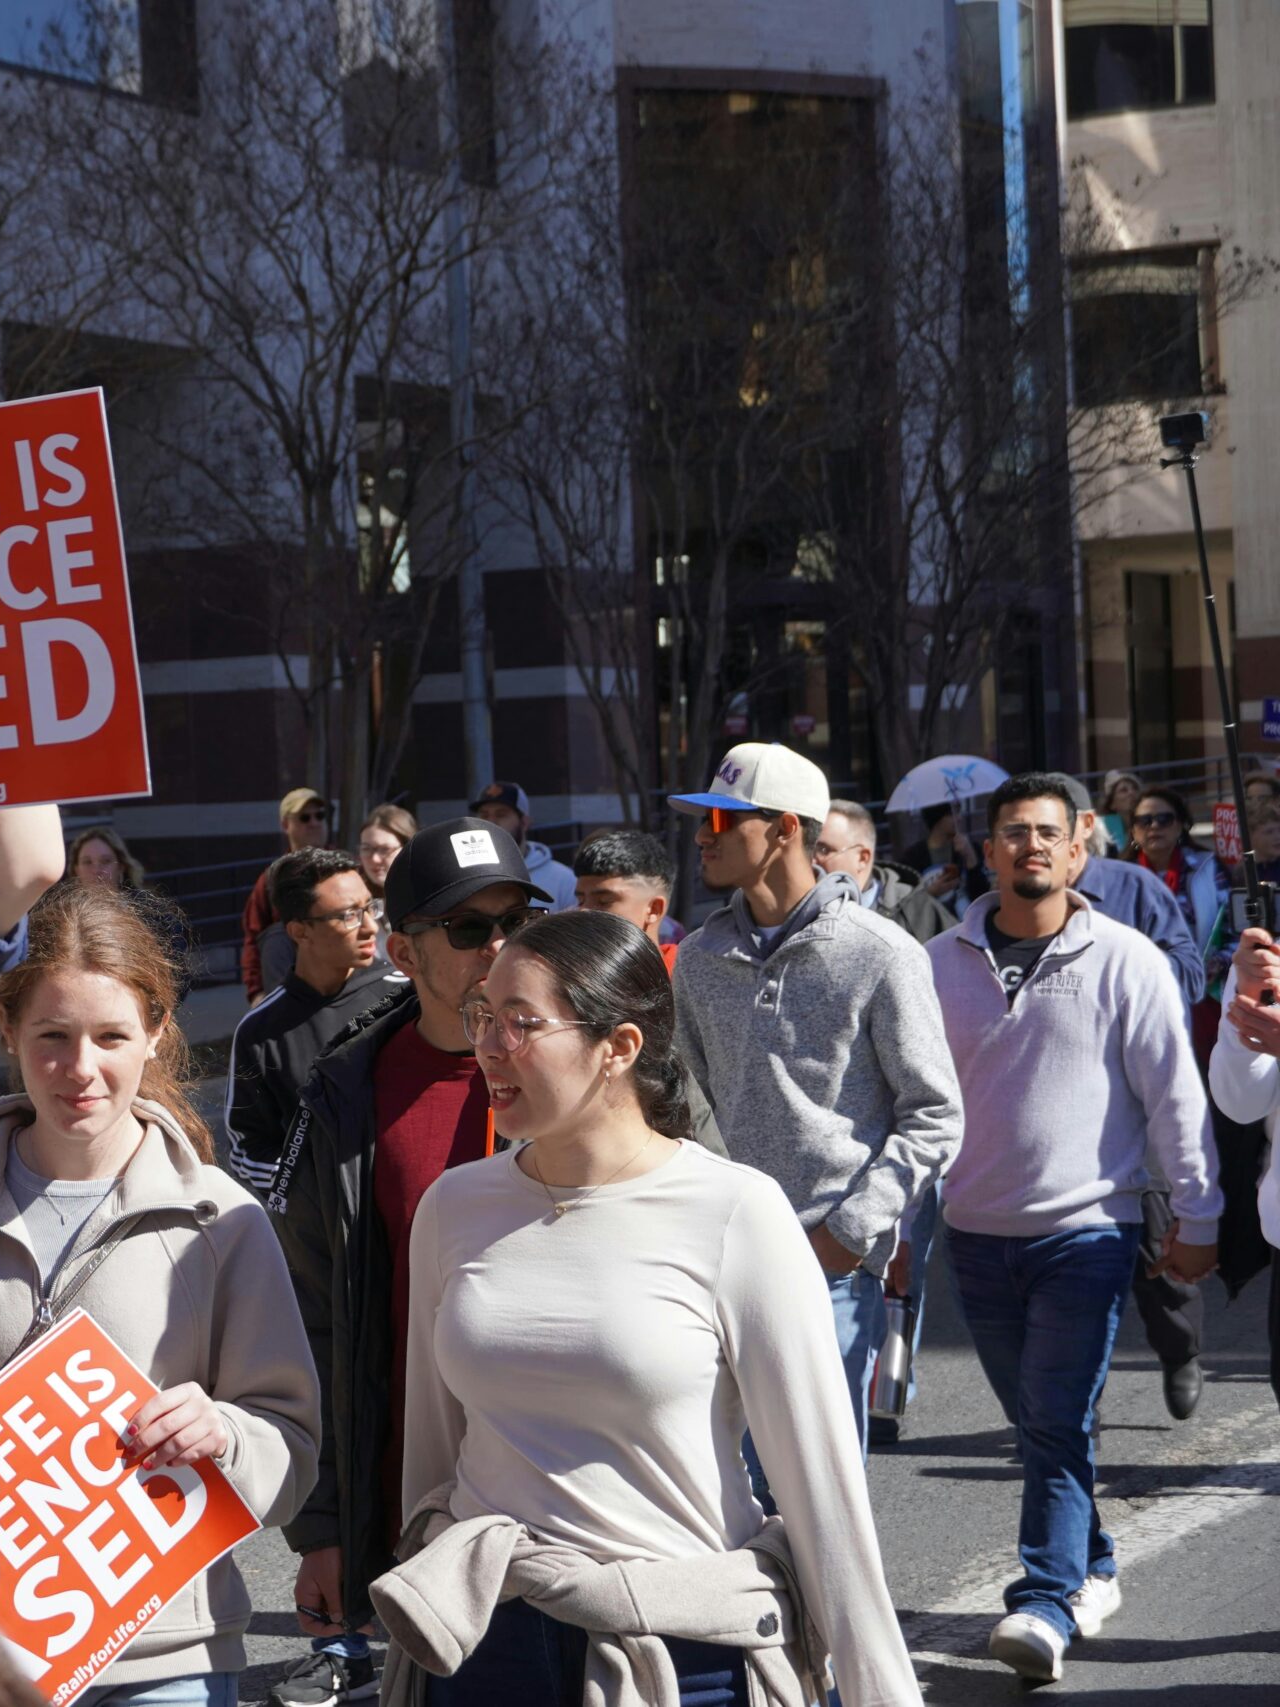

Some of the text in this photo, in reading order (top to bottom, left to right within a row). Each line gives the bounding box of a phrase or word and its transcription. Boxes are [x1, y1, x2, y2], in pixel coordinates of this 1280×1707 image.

[14, 434, 87, 511] IS
[1056, 974, 1083, 988] RIVER
[276, 1167, 292, 1196] new
[284, 1108, 311, 1167] balance
[45, 1349, 116, 1418] IS
[49, 1593, 162, 1707] sRallyforLife.org
